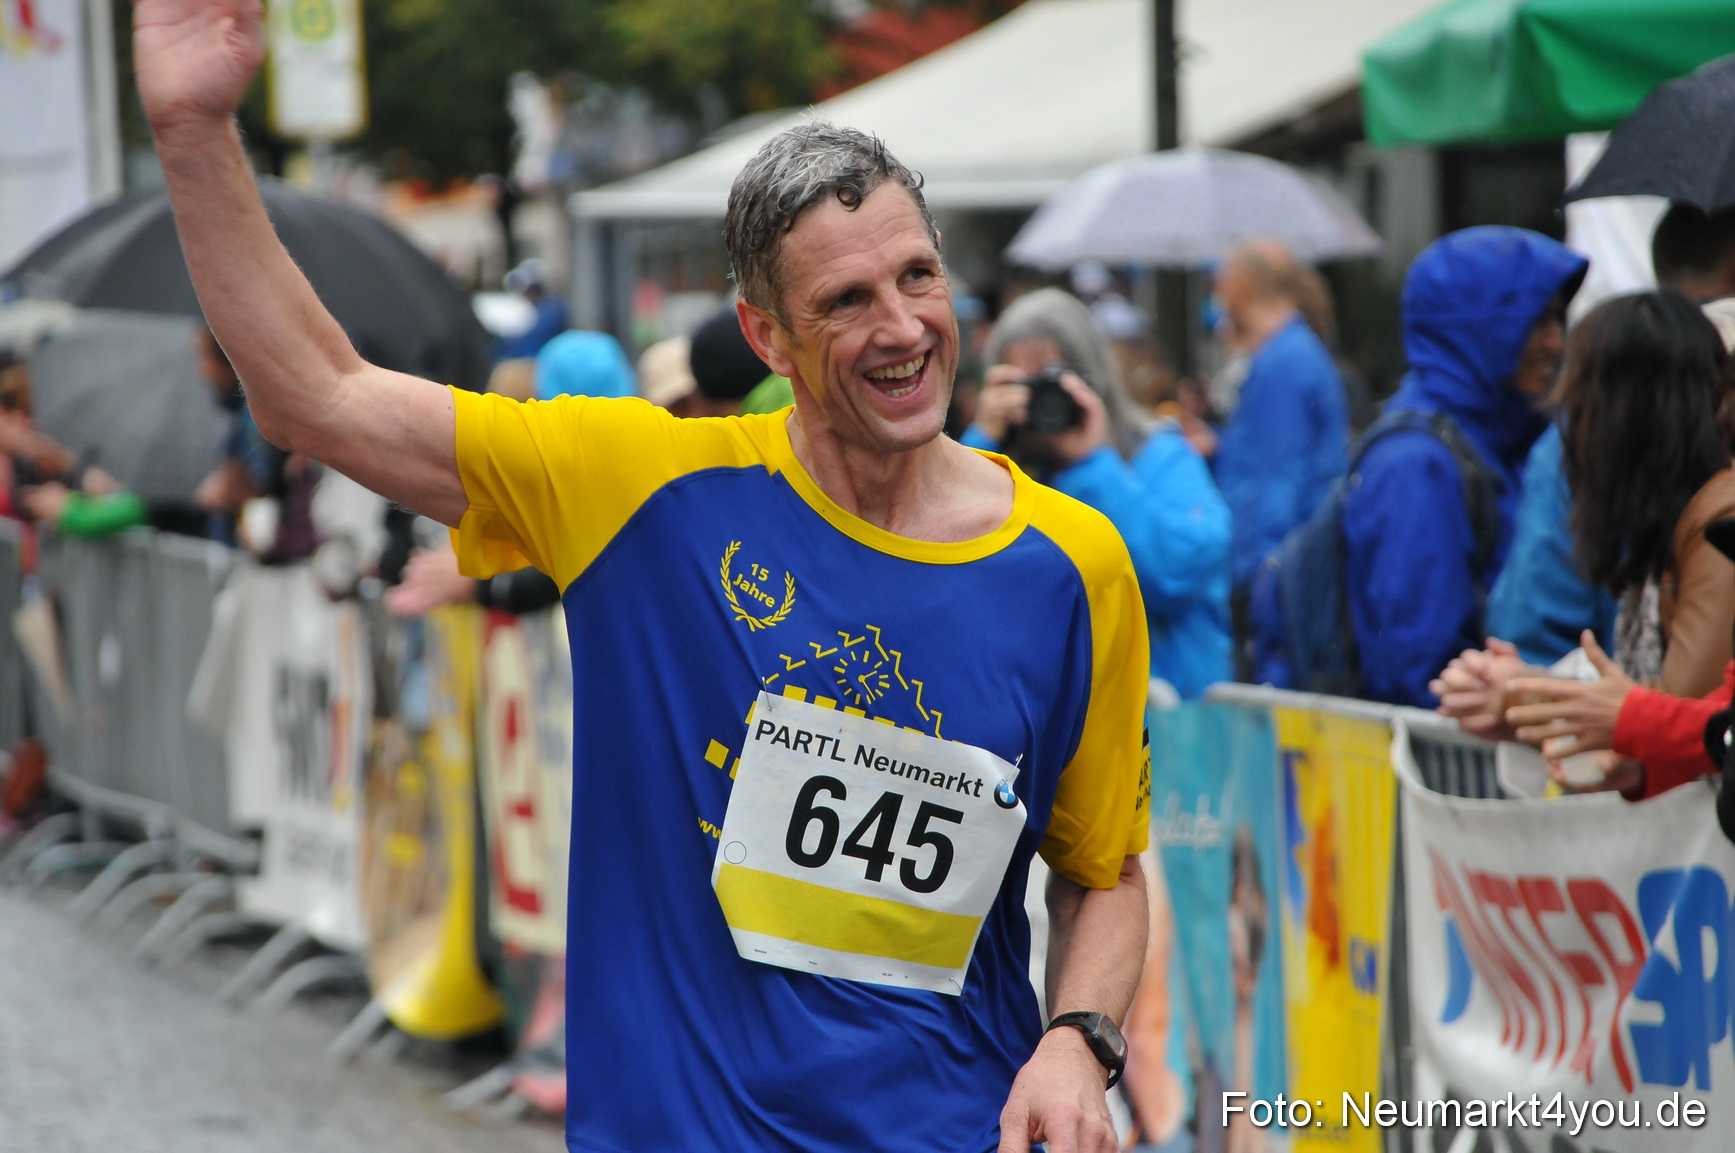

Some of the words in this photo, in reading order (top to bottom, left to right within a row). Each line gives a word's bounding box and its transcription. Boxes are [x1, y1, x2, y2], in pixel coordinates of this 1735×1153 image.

[733, 573, 775, 608] Jahre
[751, 563, 769, 581] 15
[754, 718, 846, 763] PARTL
[853, 744, 984, 798] Neumarkt
[785, 774, 965, 894] 645
